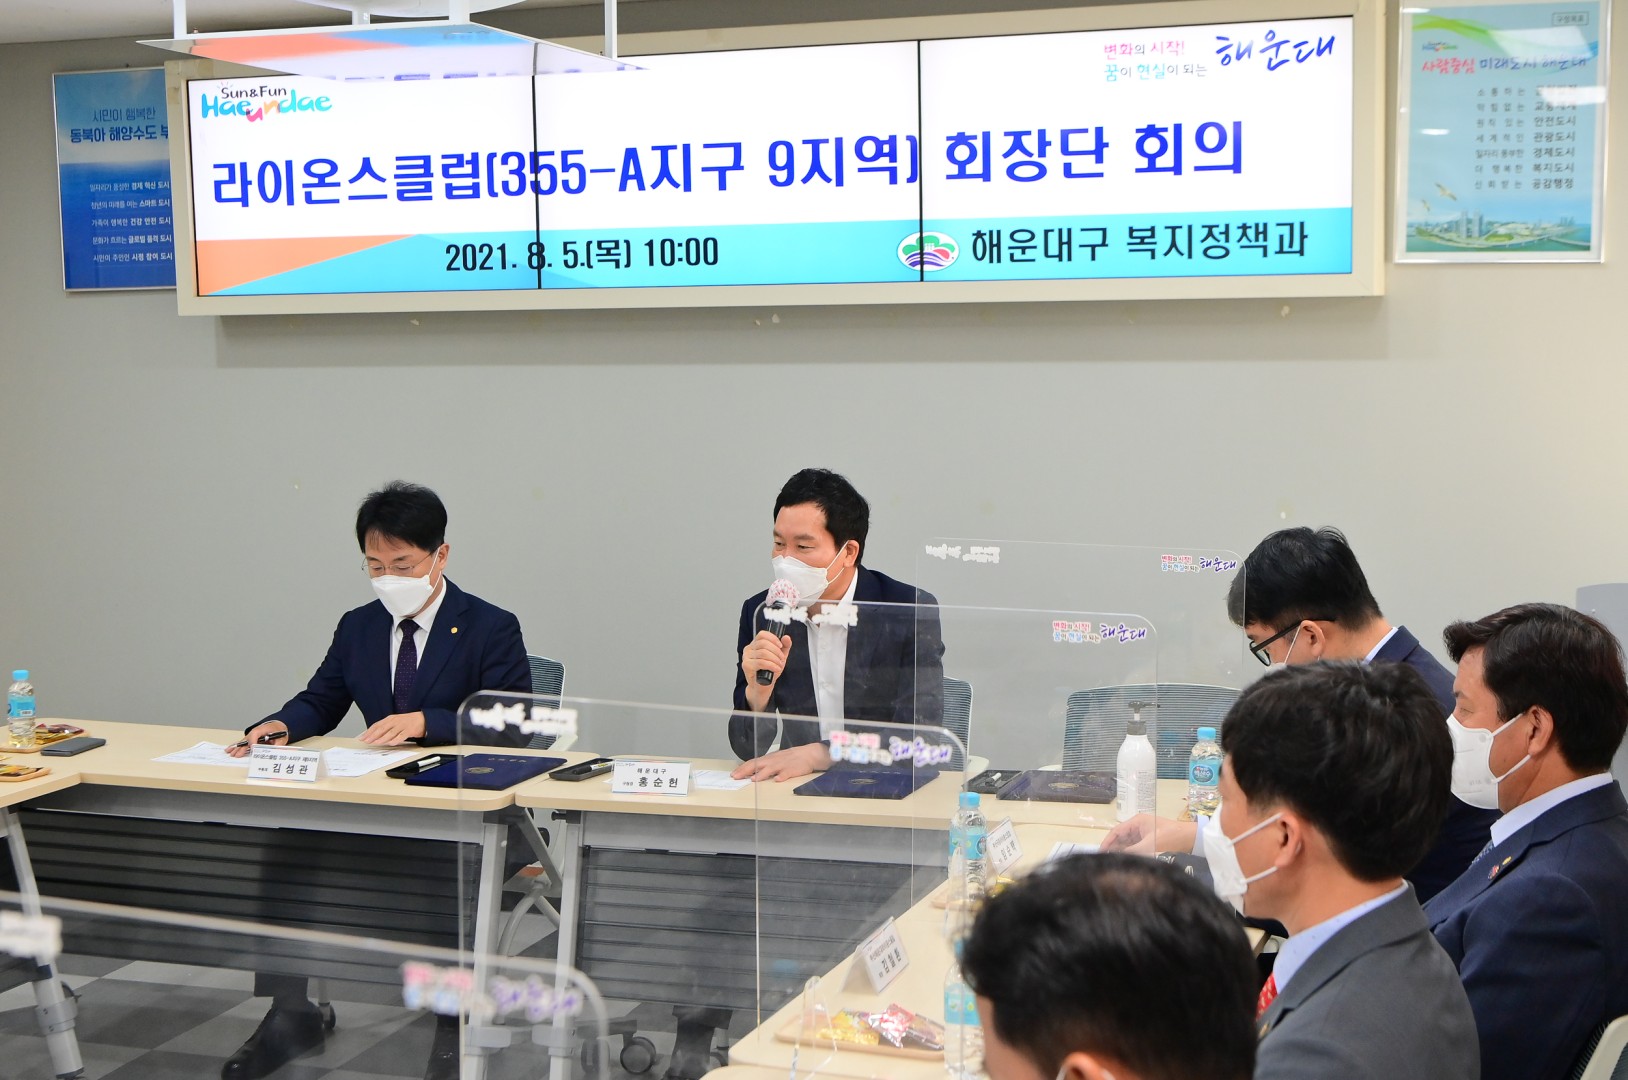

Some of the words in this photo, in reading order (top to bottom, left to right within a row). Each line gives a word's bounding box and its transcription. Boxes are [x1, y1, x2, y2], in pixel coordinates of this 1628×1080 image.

[1104, 43, 1145, 60] 변화의
[1150, 41, 1185, 55] 시작!
[1216, 29, 1335, 71] 해운대
[1422, 57, 1476, 74] 사람중심
[1104, 64, 1132, 82] 꿈이
[1137, 63, 1178, 80] 현실이
[1183, 64, 1207, 78] 되는
[221, 85, 287, 99] Sun&Fun
[201, 88, 333, 122] Haeundae
[93, 108, 122, 122] 시민이
[125, 106, 156, 120] 행복한
[1534, 116, 1577, 127] 안전도시
[70, 127, 106, 143] 동북아
[109, 125, 157, 141] 해양수도
[1534, 131, 1576, 142] 관광도시
[1533, 147, 1576, 158] 경제도시
[213, 142, 745, 207] 라이온스클럽(355-A지구
[769, 135, 918, 187] 9지역)
[946, 127, 1109, 182] 회장단
[1135, 122, 1241, 175] 회의
[1532, 162, 1575, 173] 복지도시
[157, 181, 170, 189] 도시
[1532, 178, 1575, 190] 공감행정
[139, 199, 157, 207] 스마트
[158, 198, 170, 207] 도시
[92, 218, 109, 227] 가족이
[130, 217, 142, 226] 건강
[144, 217, 157, 225] 안전
[158, 216, 171, 225] 도시
[128, 235, 146, 244] 글로벌
[160, 234, 172, 243] 도시
[972, 228, 1109, 263] 해운대구
[1127, 221, 1309, 260] 복지정책과
[93, 254, 111, 262] 시민이
[160, 252, 173, 260] 도시
[445, 244, 518, 271] 2021.
[527, 242, 552, 271] 8.
[563, 239, 631, 269] 5.(목)
[644, 237, 718, 266] 10:00
[1161, 555, 1178, 563] 변화의
[1178, 555, 1192, 564] 시작!
[1199, 556, 1237, 572] 해운대
[1053, 622, 1073, 631] 변화의
[1074, 622, 1090, 632] 시작!
[1100, 623, 1147, 643] 해운대
[1053, 631, 1067, 641] 꿈이
[1068, 631, 1088, 642] 현실이
[273, 763, 308, 775] 김성관
[638, 776, 678, 788] 홍순헌
